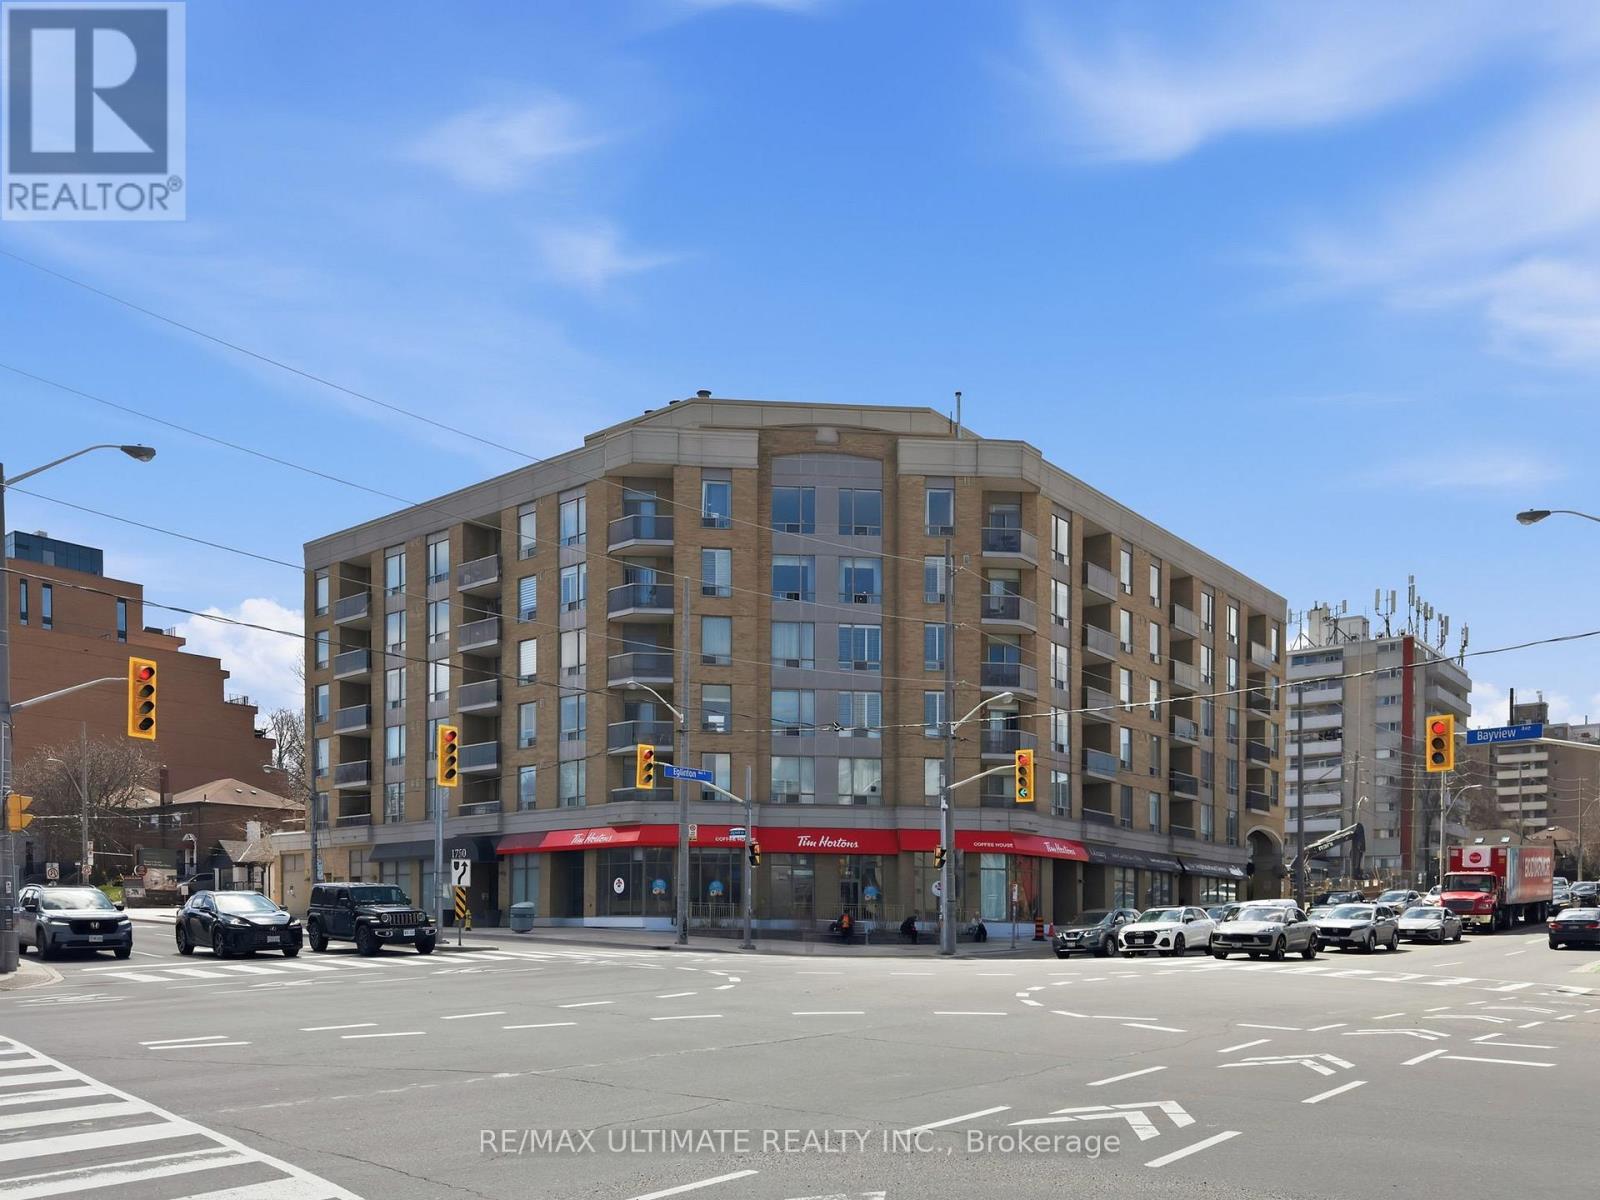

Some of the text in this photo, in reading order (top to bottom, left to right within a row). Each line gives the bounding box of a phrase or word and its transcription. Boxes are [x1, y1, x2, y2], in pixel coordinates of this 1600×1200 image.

[1477, 727, 1516, 741] Bayview
[673, 767, 697, 778] Eglinton
[797, 835, 859, 848] Tim Hortons
